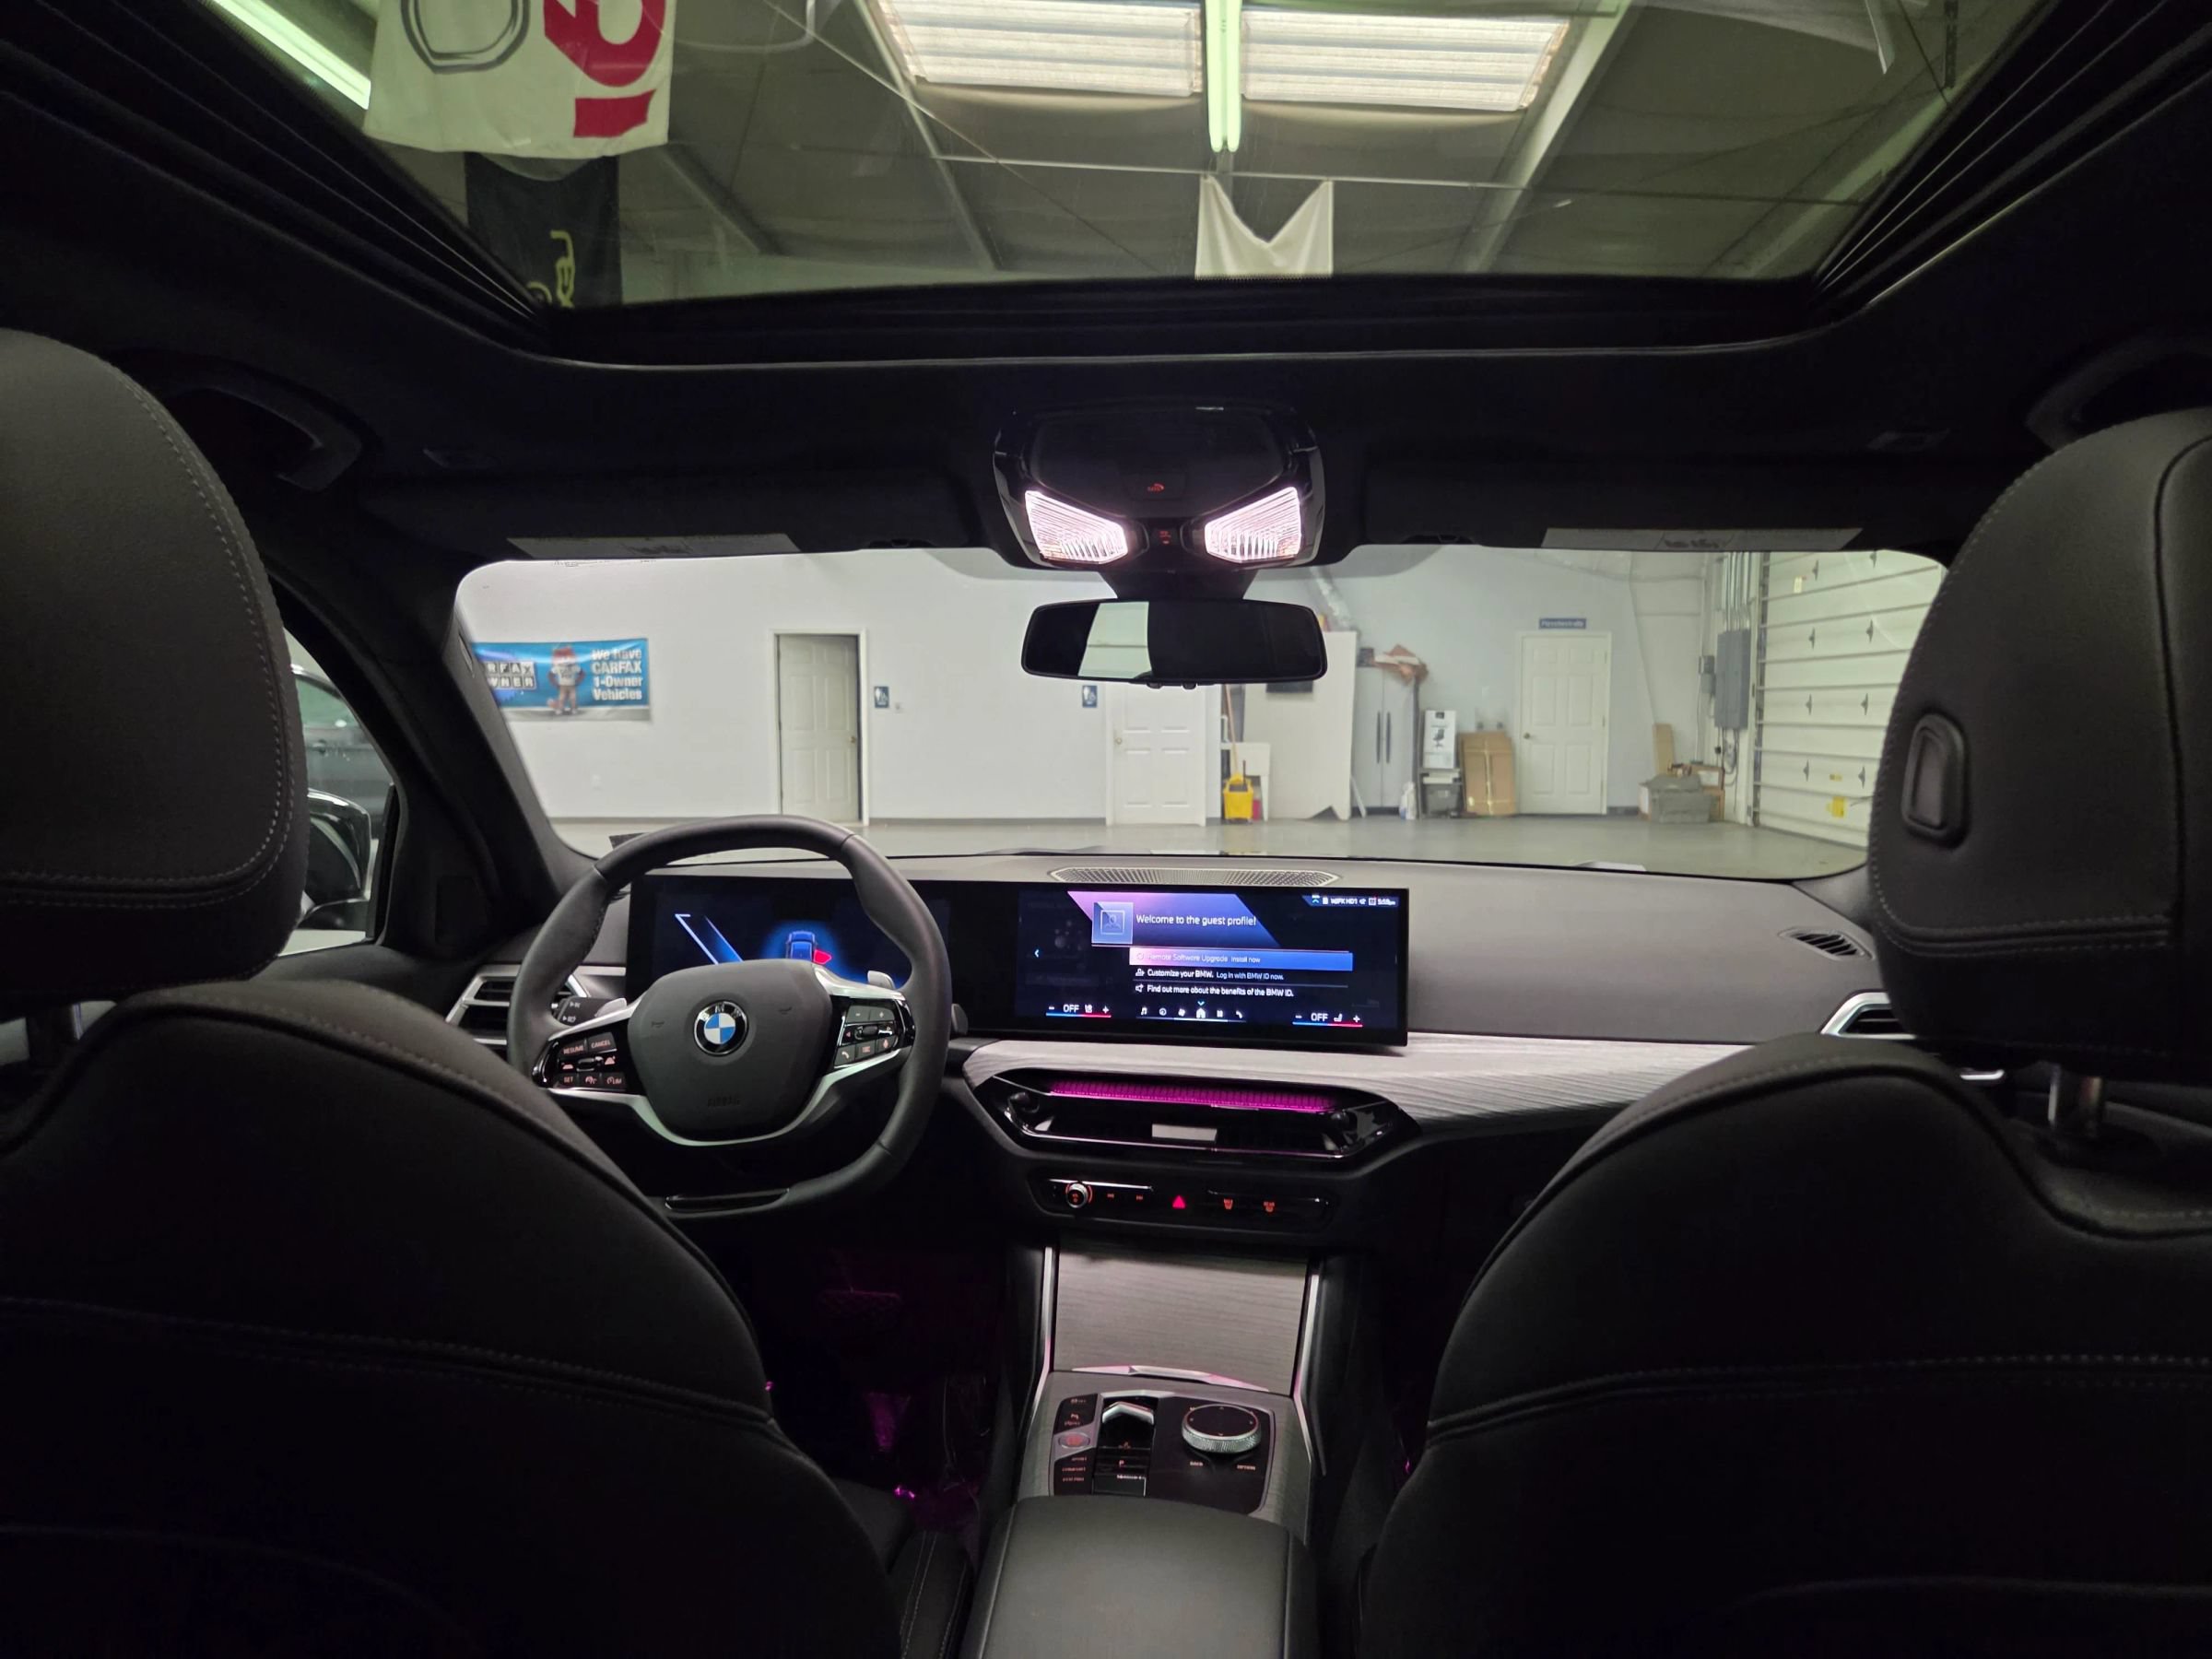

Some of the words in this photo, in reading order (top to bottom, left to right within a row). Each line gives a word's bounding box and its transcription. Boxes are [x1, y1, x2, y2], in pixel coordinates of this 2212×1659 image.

[592, 649, 609, 660] We
[592, 660, 642, 674] CARFAX
[594, 676, 642, 688] 1-Owner
[594, 688, 642, 700] Vehicles
[1136, 914, 1174, 924] Welcome
[1176, 916, 1184, 924] to
[1186, 915, 1200, 924] the
[1202, 917, 1226, 926] guest
[1227, 915, 1257, 927] profile!
[1172, 953, 1201, 961] Software
[1201, 955, 1228, 964] Upgrade
[1147, 969, 1179, 977] Customize
[1180, 971, 1194, 979] your
[1217, 971, 1227, 980] Log
[1147, 984, 1161, 993] Find
[1190, 985, 1209, 994] about
[1209, 986, 1220, 994] the
[1221, 987, 1246, 995] benefits
[1254, 988, 1265, 996] the
[1265, 988, 1284, 996] BMW
[1063, 1004, 1079, 1013] OFF
[1311, 1012, 1328, 1022] OFF
[563, 1044, 584, 1054] RESUME
[591, 1040, 611, 1049] CANCEL
